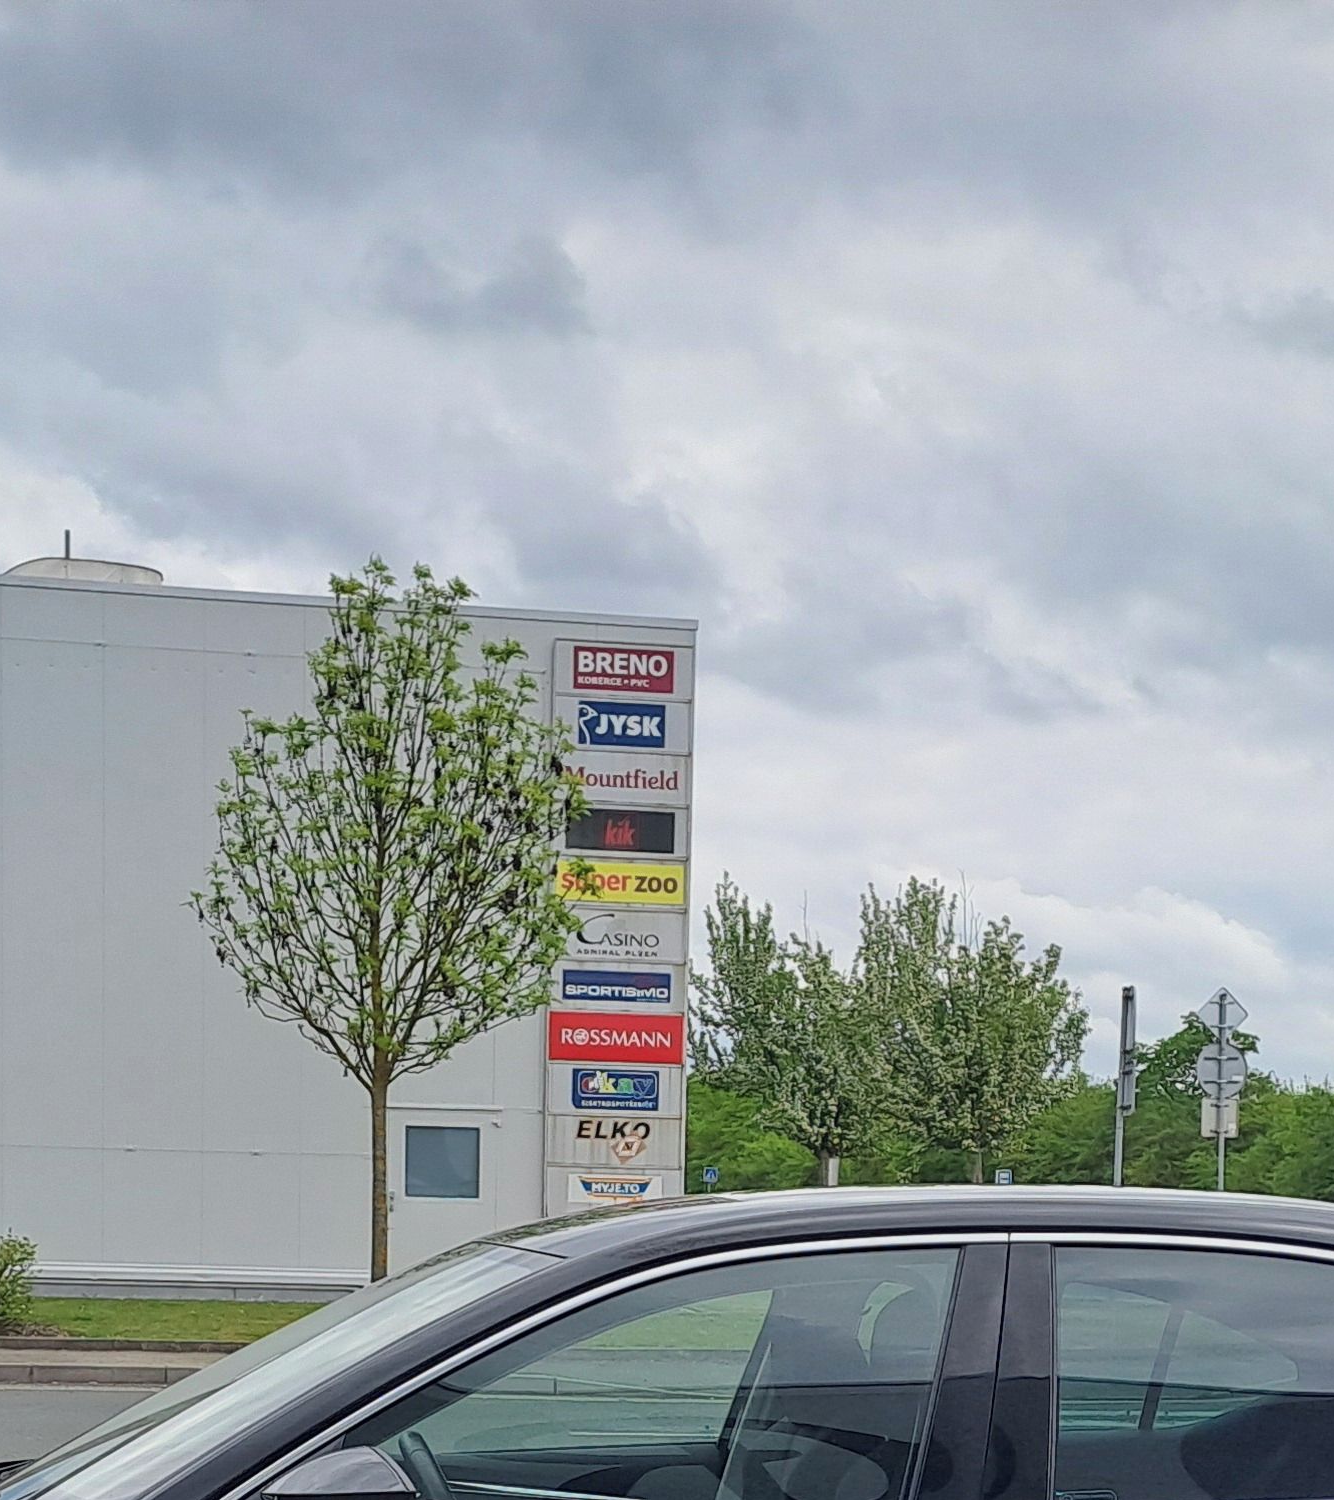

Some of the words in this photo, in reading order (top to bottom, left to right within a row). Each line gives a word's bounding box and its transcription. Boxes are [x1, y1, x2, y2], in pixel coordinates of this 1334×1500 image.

[578, 651, 668, 677] BRENO
[595, 713, 662, 737] JYSK
[565, 766, 679, 790] Mountfield
[634, 875, 678, 894] zoo
[561, 1028, 672, 1048] ROSSMANN
[576, 1120, 651, 1140] ELKO
